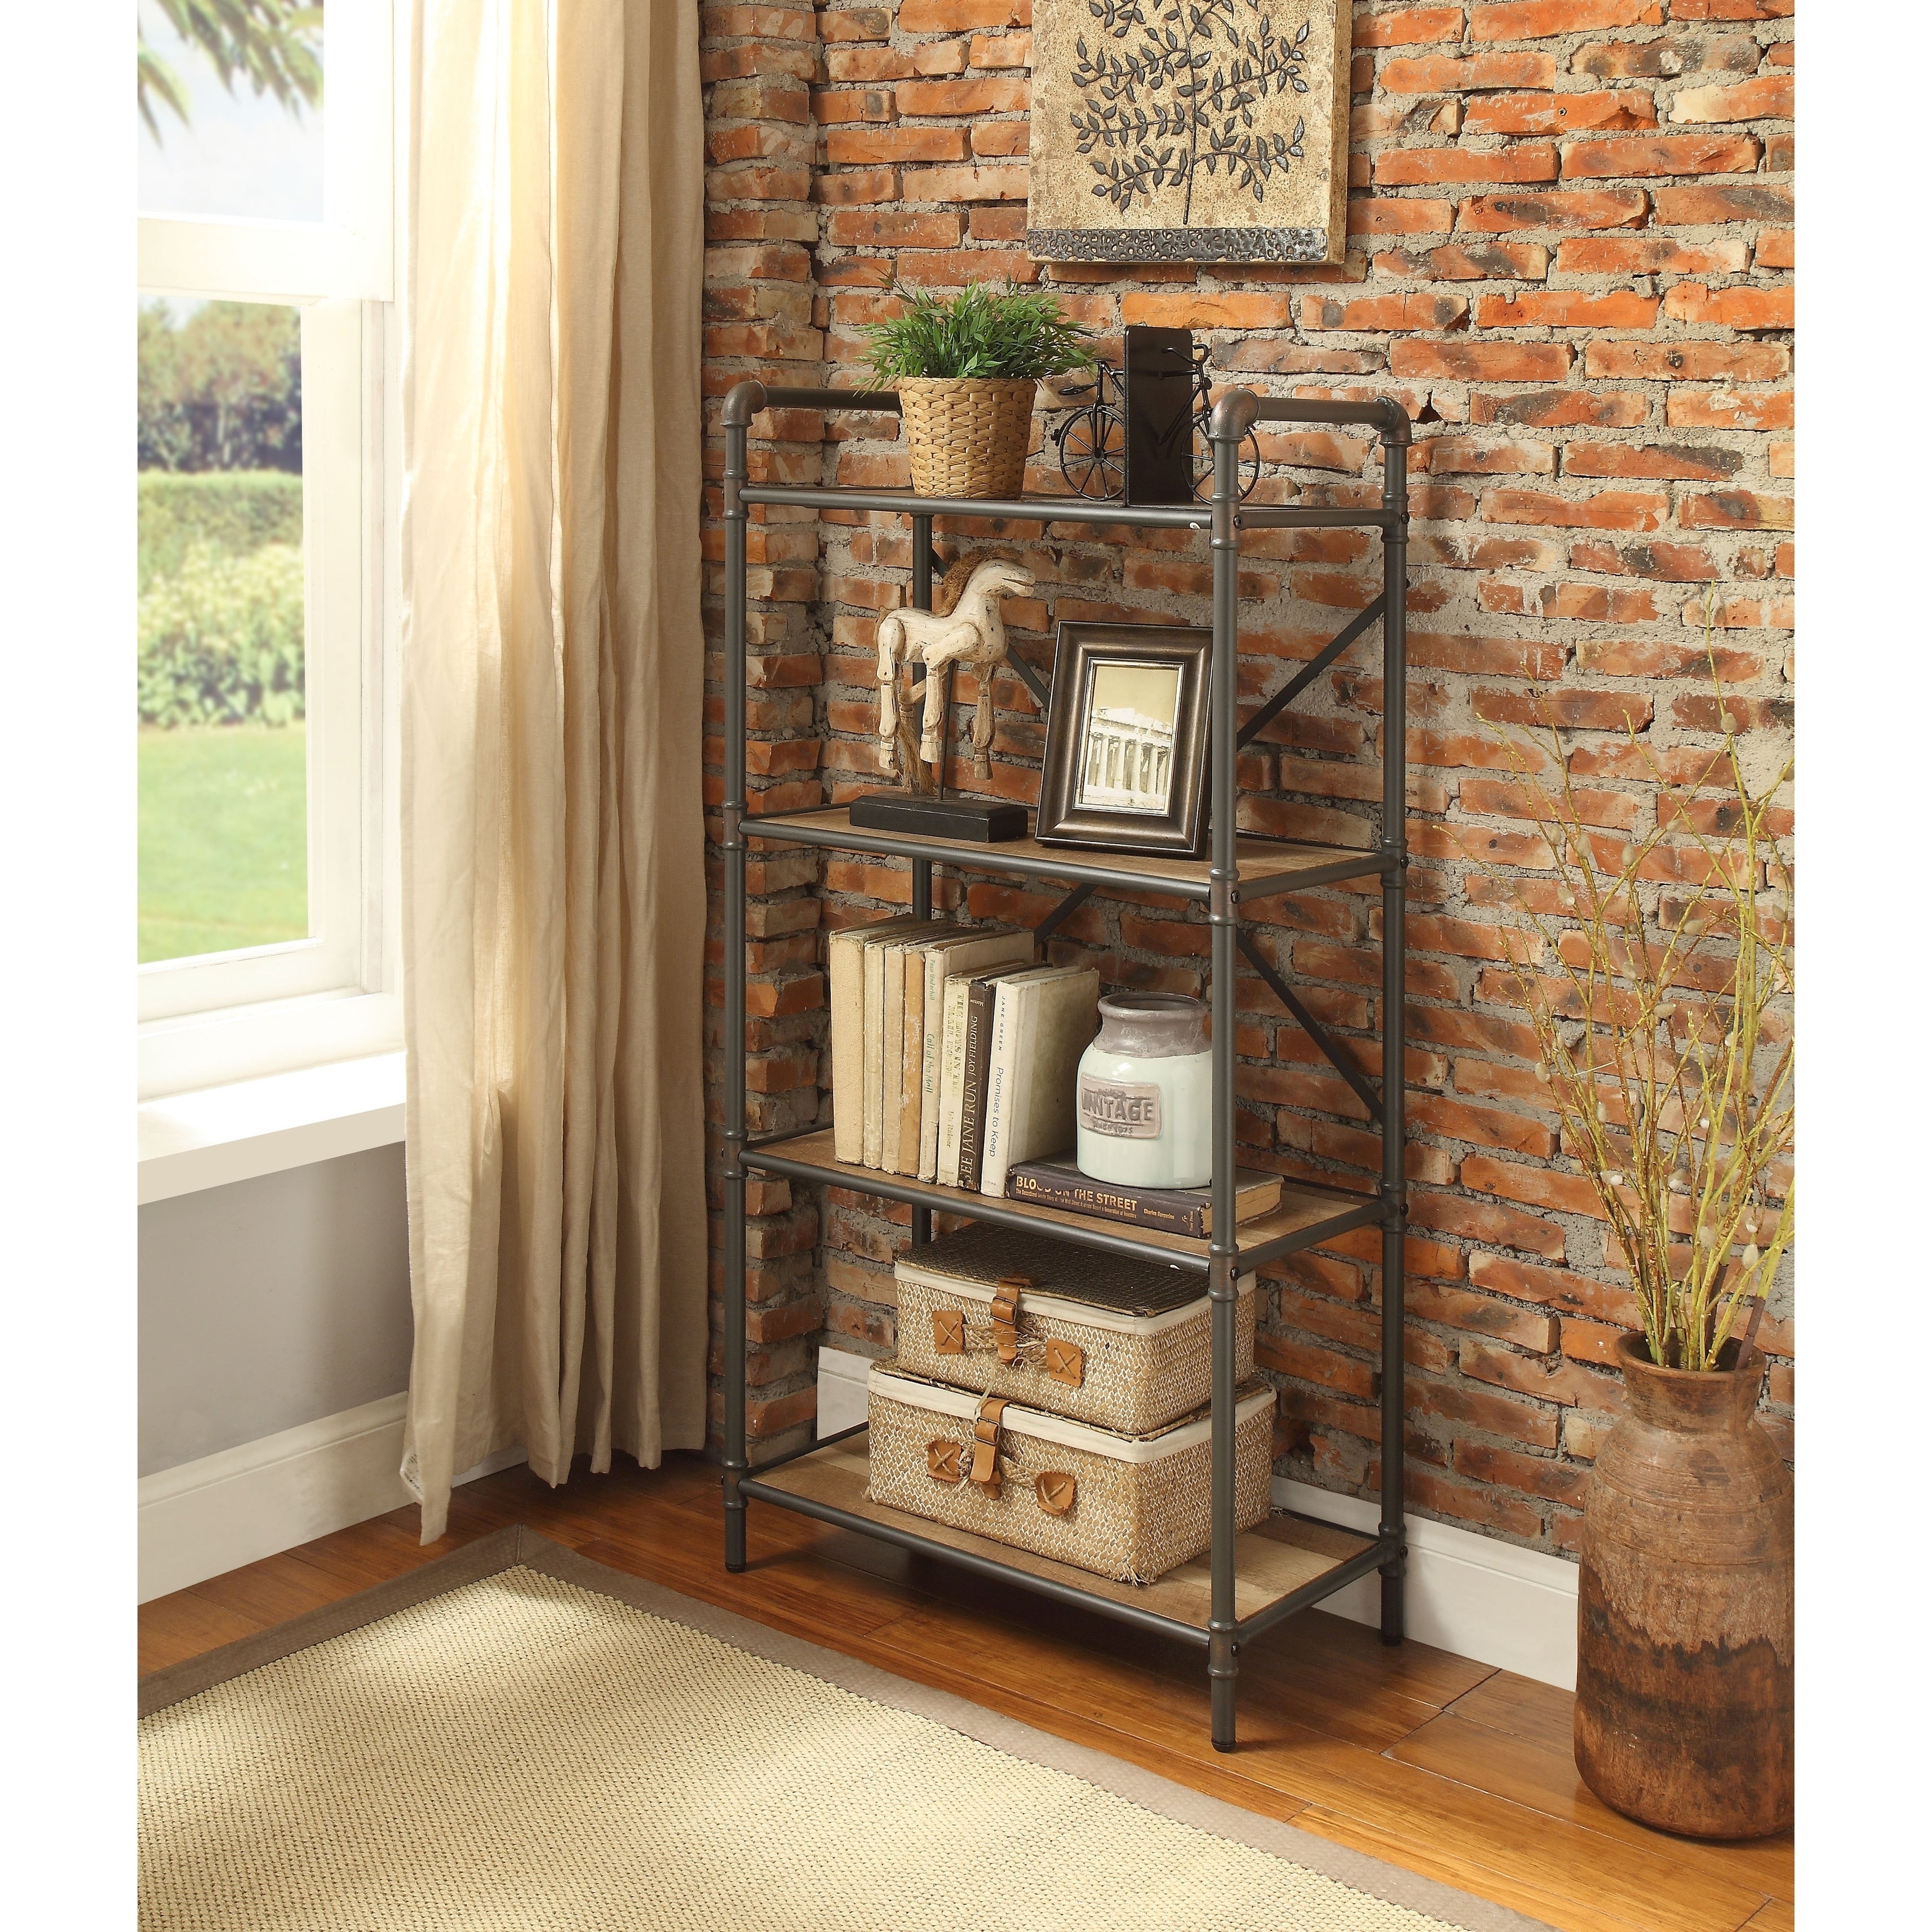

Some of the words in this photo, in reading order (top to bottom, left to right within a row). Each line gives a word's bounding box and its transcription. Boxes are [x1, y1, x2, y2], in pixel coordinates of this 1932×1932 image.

[927, 1034, 935, 1049] Call
[969, 1015, 978, 1058] FIELDING
[926, 1051, 934, 1060] of
[968, 1058, 977, 1076] JOY
[964, 1080, 977, 1114] RUN
[993, 1067, 1004, 1114] Promises
[992, 1116, 1000, 1127] to
[961, 1115, 976, 1155] JANE
[989, 1130, 999, 1157] Keep
[1074, 1189, 1093, 1202] THE
[1096, 1193, 1137, 1211] STREET
